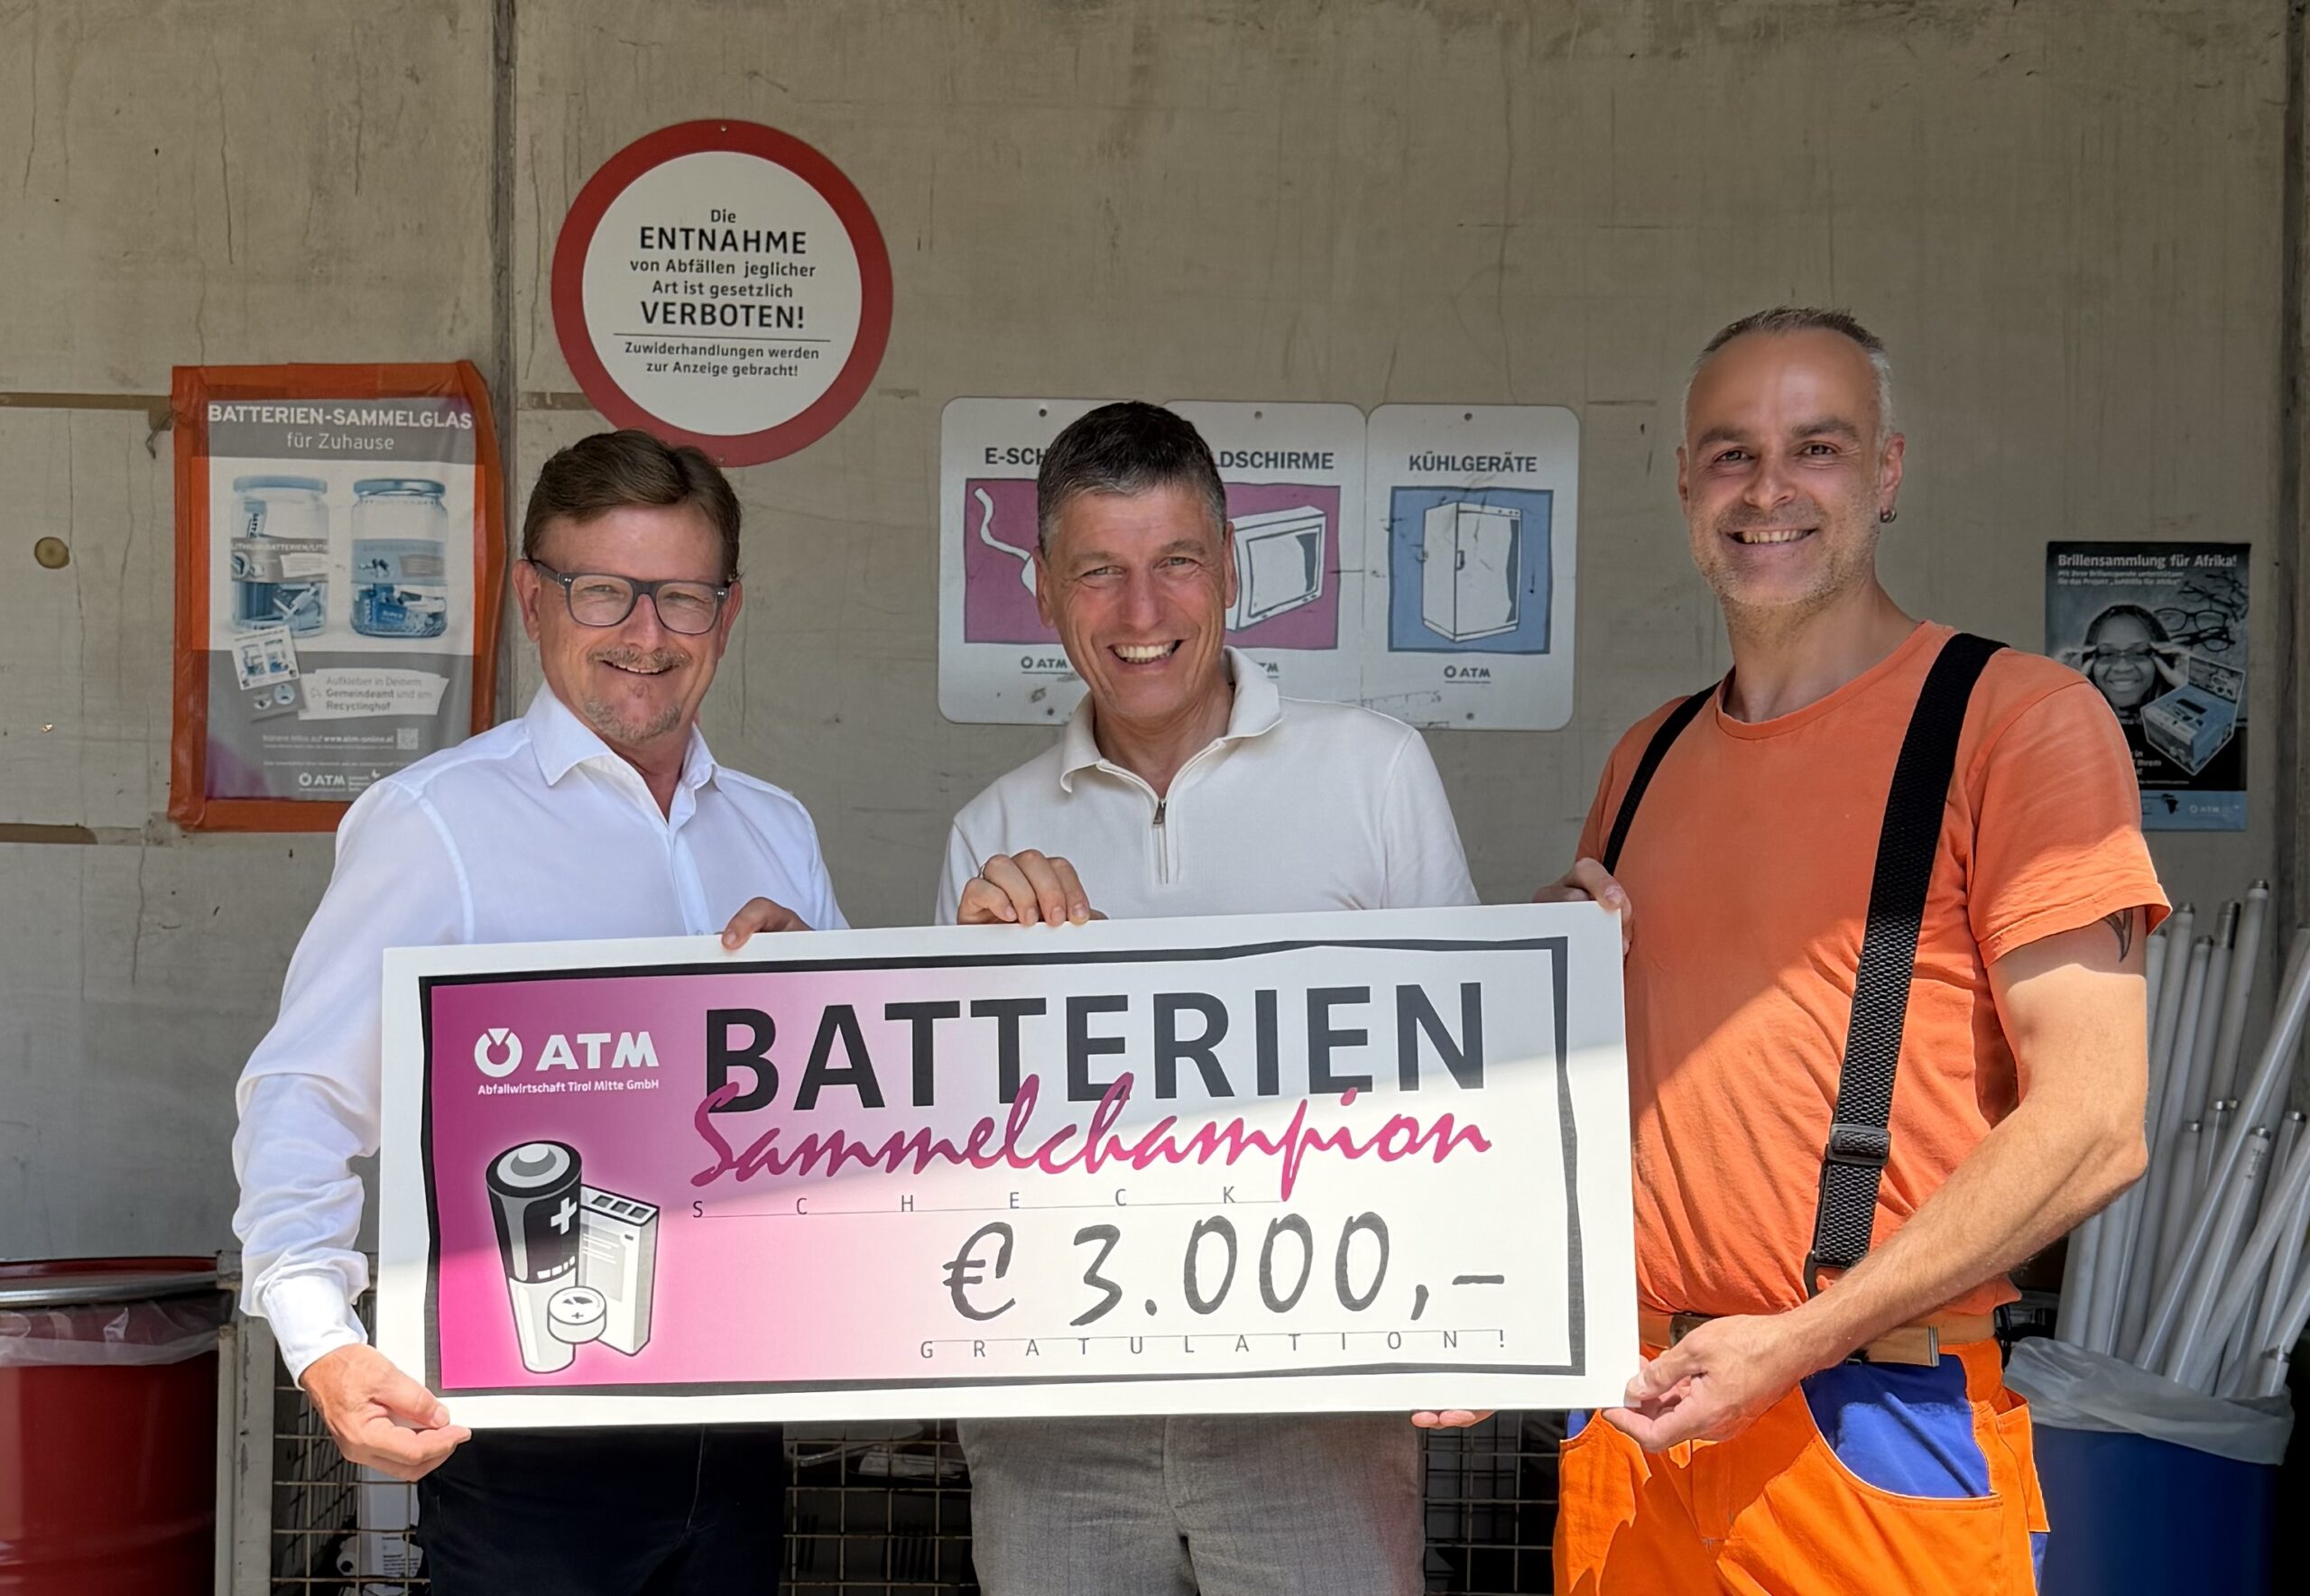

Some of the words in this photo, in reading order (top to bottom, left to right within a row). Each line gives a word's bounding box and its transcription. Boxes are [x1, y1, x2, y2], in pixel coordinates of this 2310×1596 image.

[710, 208, 737, 224] Die
[640, 226, 807, 254] ENTNAHME
[630, 260, 661, 272] von
[666, 258, 735, 274] Abfällen
[744, 261, 816, 279] jeglicher
[652, 281, 679, 294] Art
[684, 281, 704, 295] ist
[709, 282, 793, 300] gesetzlich
[641, 300, 805, 329] VERBOTEN!
[624, 342, 764, 359] Zuwiderhandlungen
[768, 346, 819, 359] werden
[646, 363, 669, 373] zur
[672, 361, 728, 376] Anzeige
[732, 363, 799, 377] gebracht!
[208, 404, 473, 429] BATTERIEN-SAMMELGLAS
[286, 432, 311, 448] für
[318, 433, 395, 450] Zuhause
[984, 447, 1048, 466] E-SCH
[1215, 450, 1335, 470] DSCHIRME
[1409, 449, 1538, 474] KÜHLGERÄTE
[2057, 554, 2167, 569] Brillensammlung
[2170, 554, 2191, 567] für
[2194, 554, 2238, 567] Afrika!
[1036, 659, 1068, 669] ATM
[1459, 668, 1491, 678] ATM
[326, 687, 394, 698] Gemeindeamt
[326, 700, 391, 712] Recyclinghof
[314, 774, 346, 786] ATM
[535, 1031, 660, 1072] ATM
[706, 982, 1485, 1114] BATTERIEN
[477, 1082, 566, 1095] Abfallwirtschaft
[568, 1081, 592, 1092] Tirol
[594, 1080, 624, 1091] Mitte
[626, 1078, 660, 1090] GmbH
[690, 1072, 1492, 1202] Sammelchampion
[943, 1222, 1016, 1322] €
